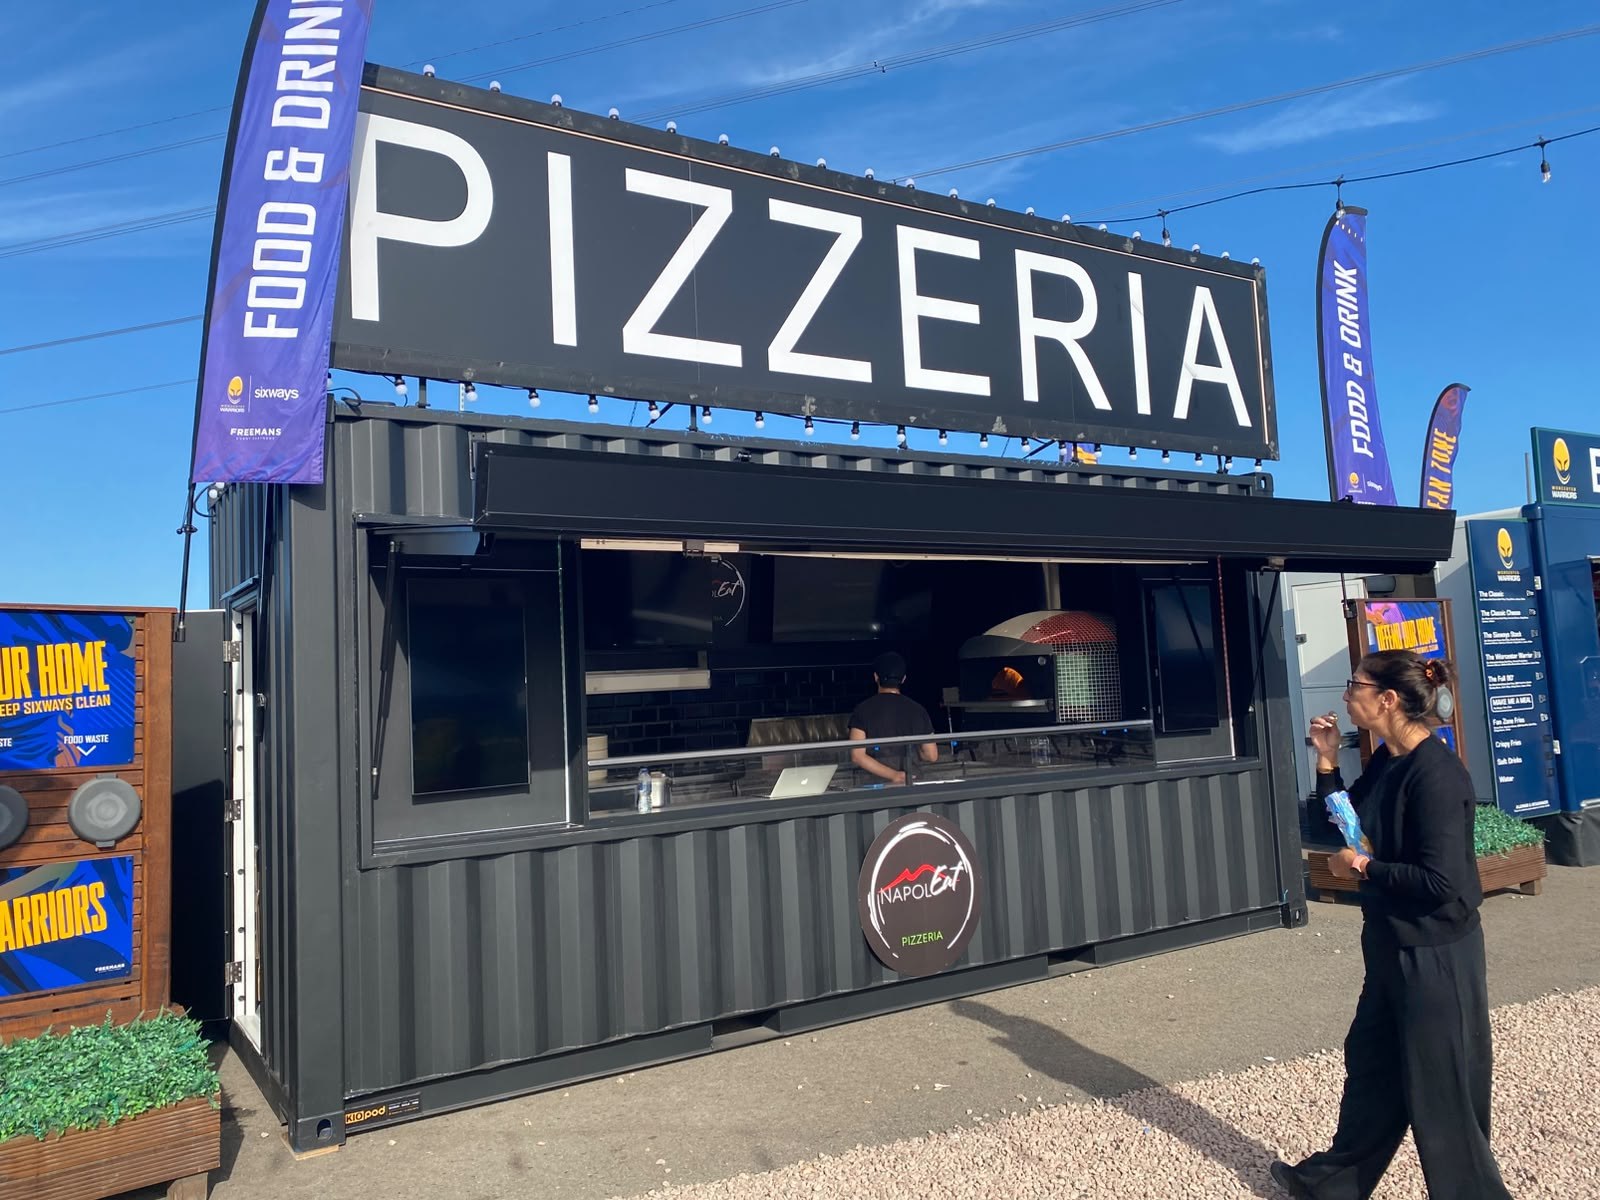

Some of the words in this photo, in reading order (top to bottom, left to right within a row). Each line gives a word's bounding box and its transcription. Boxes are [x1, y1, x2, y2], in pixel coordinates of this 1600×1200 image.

[271, 0, 344, 130] DRIN
[263, 147, 325, 183] &
[243, 201, 317, 338] FOOD
[350, 111, 1252, 428] PIZZERIA
[1333, 260, 1362, 349] DRINK
[1343, 353, 1363, 377] &
[254, 386, 299, 400] sixways
[230, 428, 282, 436] FREEMANS
[1346, 380, 1374, 458] FOOD
[1431, 428, 1457, 474] ZONE
[1552, 491, 1578, 499] WARRIORS
[1416, 616, 1438, 646] HOME
[0, 645, 33, 701] UR
[36, 640, 110, 698] HOME
[0, 702, 20, 717] EEP
[23, 698, 74, 715] SIXWAYS
[75, 693, 111, 710] CLEAN
[64, 735, 84, 745] FOOD
[85, 734, 109, 744] WASTE
[0, 881, 108, 953] ARRIORS
[902, 931, 944, 947] PIZZERIA
